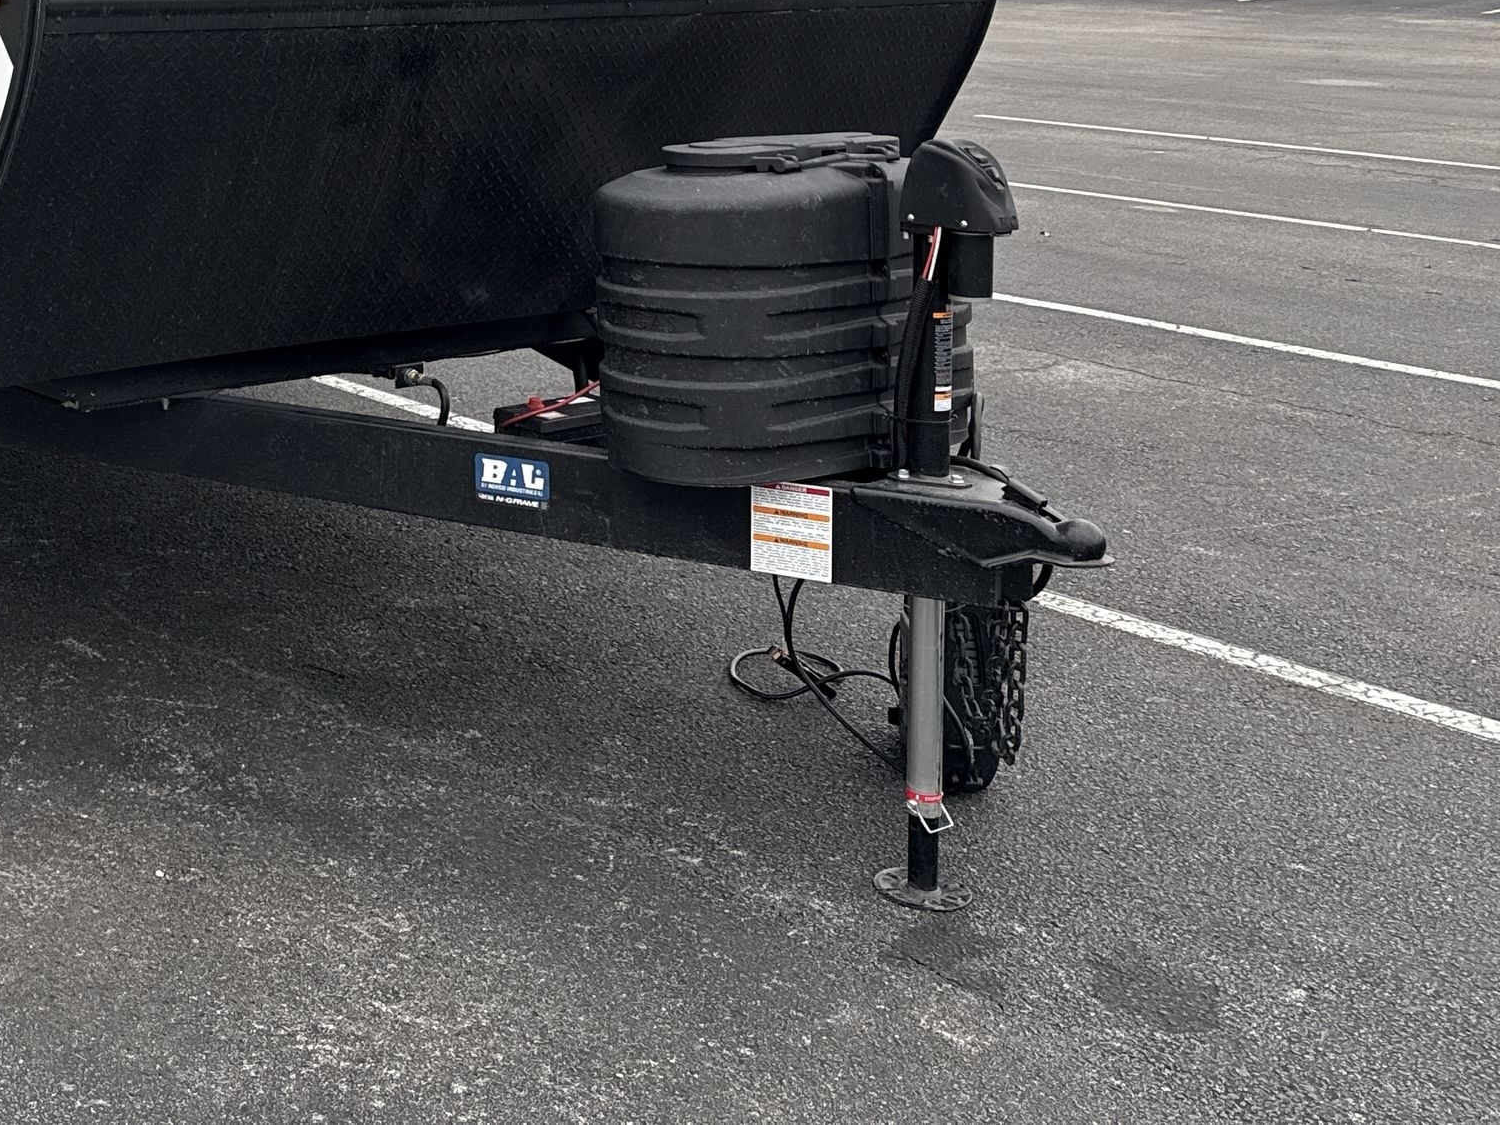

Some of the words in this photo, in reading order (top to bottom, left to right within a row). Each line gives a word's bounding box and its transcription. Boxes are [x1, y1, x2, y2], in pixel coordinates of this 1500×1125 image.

[481, 458, 544, 490] BAL
[781, 484, 807, 493] DANGER
[779, 509, 808, 519] WARNING
[779, 537, 808, 547] WARNING
